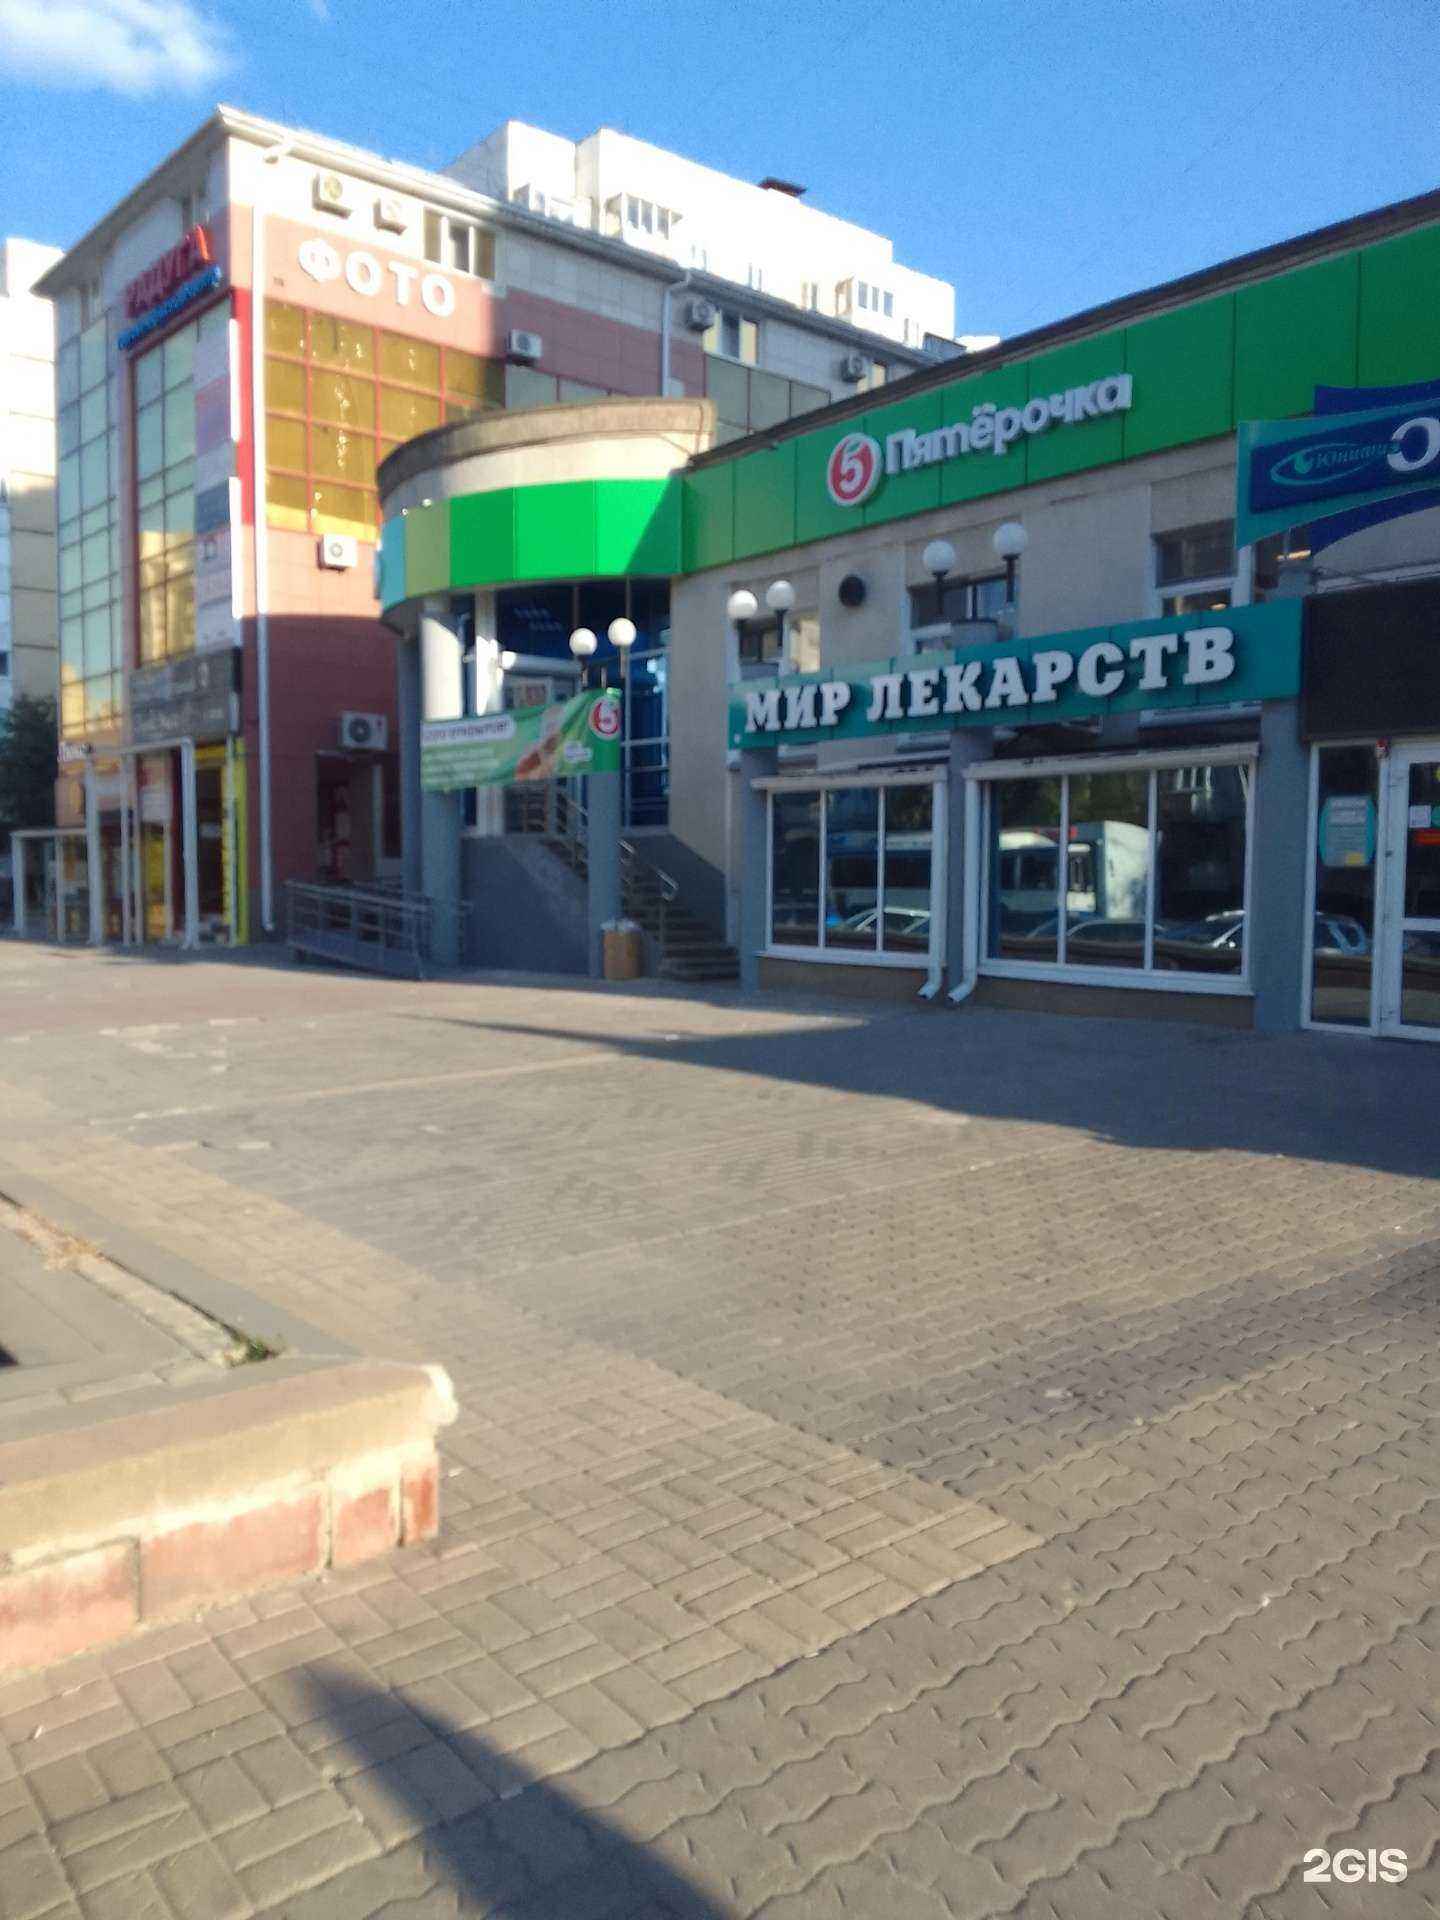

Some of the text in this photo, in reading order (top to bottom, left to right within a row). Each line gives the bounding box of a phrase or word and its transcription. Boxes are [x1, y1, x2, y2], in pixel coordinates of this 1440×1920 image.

[297, 238, 456, 317] ФОТО
[884, 374, 1133, 474] Пятёрочка
[744, 626, 1236, 733] МИР ЛЕКАРСТВ
